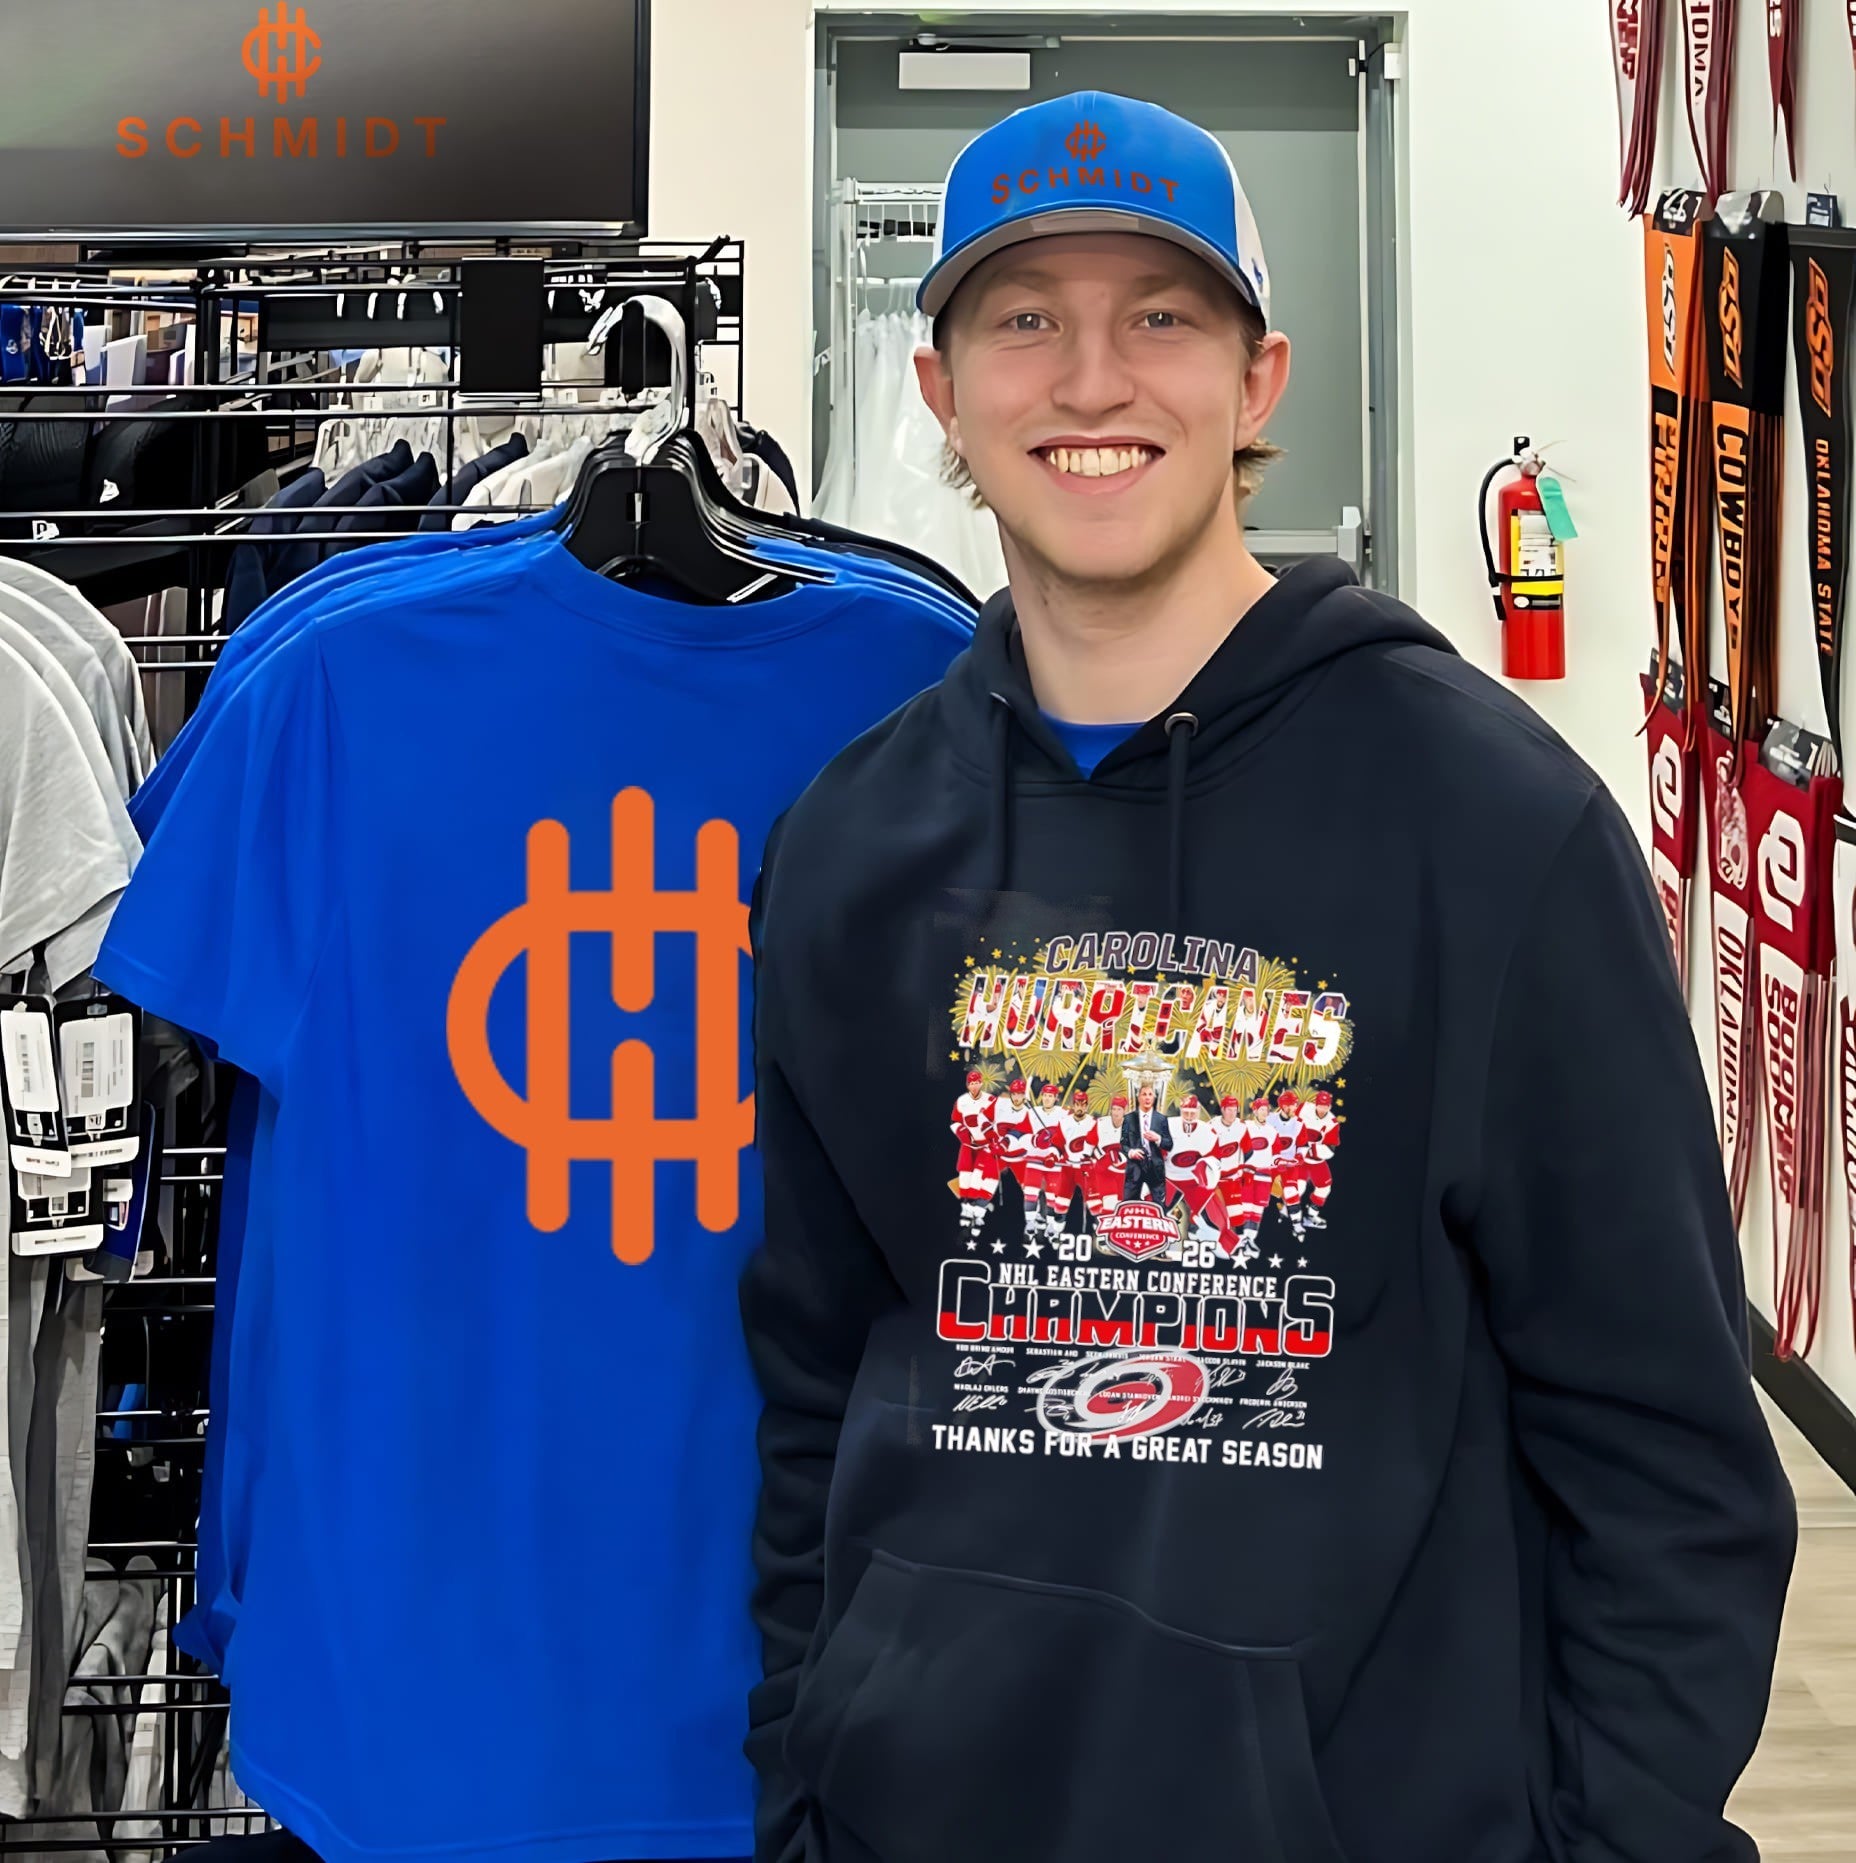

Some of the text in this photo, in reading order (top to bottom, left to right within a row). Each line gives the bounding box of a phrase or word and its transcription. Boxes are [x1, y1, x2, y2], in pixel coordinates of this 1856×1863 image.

[115, 116, 447, 158] SCHMIDT
[991, 167, 1179, 204] SCHMIDT
[1044, 931, 1259, 985] CAROLINA
[959, 974, 1349, 1065] HURRICANES
[1100, 1216, 1176, 1235] EASTERN
[1123, 1207, 1154, 1216] NHL
[1057, 1233, 1217, 1269] 20 26
[1115, 1232, 1160, 1241] CONFERENCE
[1000, 1262, 1277, 1298] NHL EASTERN CONFERENCE
[936, 1258, 1336, 1359] CHAMPIONS
[932, 1424, 1323, 1469] THANKS FOR A GREAT SEASON
